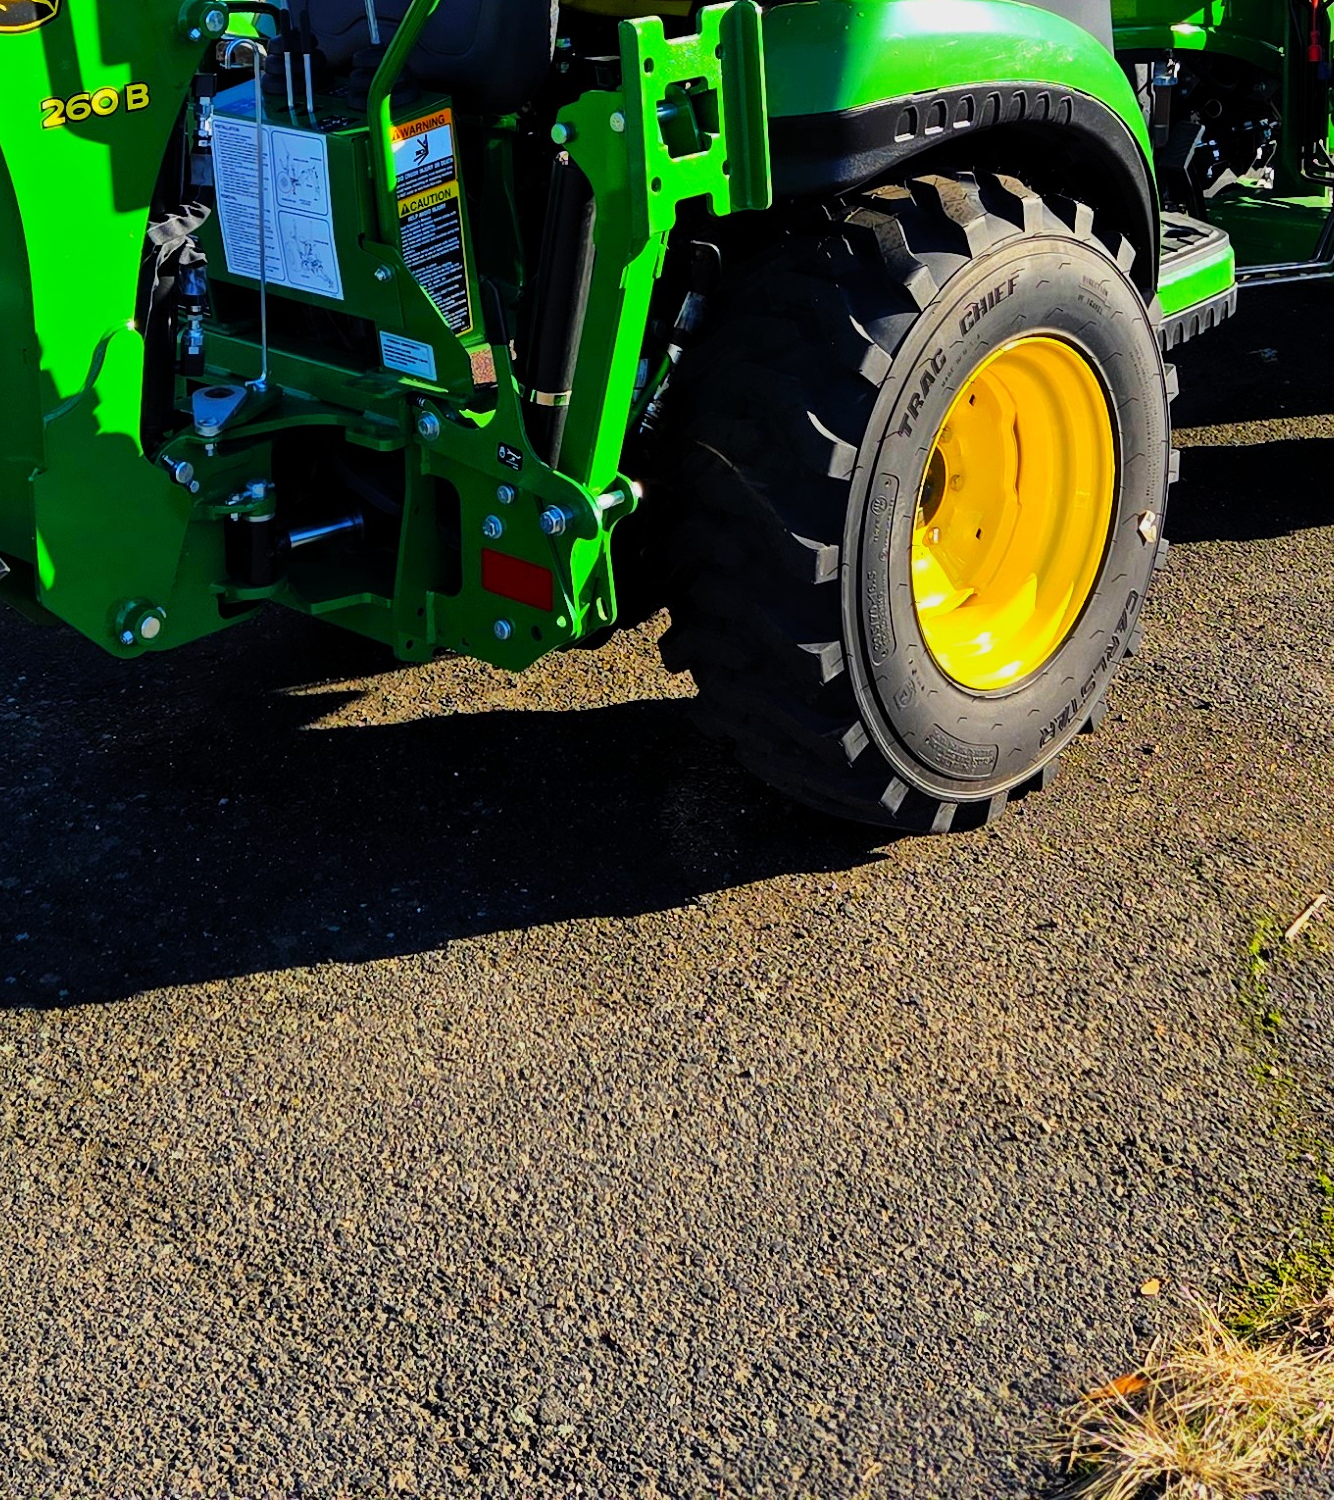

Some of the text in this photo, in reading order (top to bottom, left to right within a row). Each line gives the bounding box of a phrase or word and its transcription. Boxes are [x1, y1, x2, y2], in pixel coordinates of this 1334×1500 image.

[41, 82, 150, 129] 260 B
[400, 114, 446, 138] WARNING
[410, 188, 452, 212] CAUTION
[898, 274, 1020, 438] TRAC CHIEF
[1039, 588, 1139, 748] CARLSTAR
